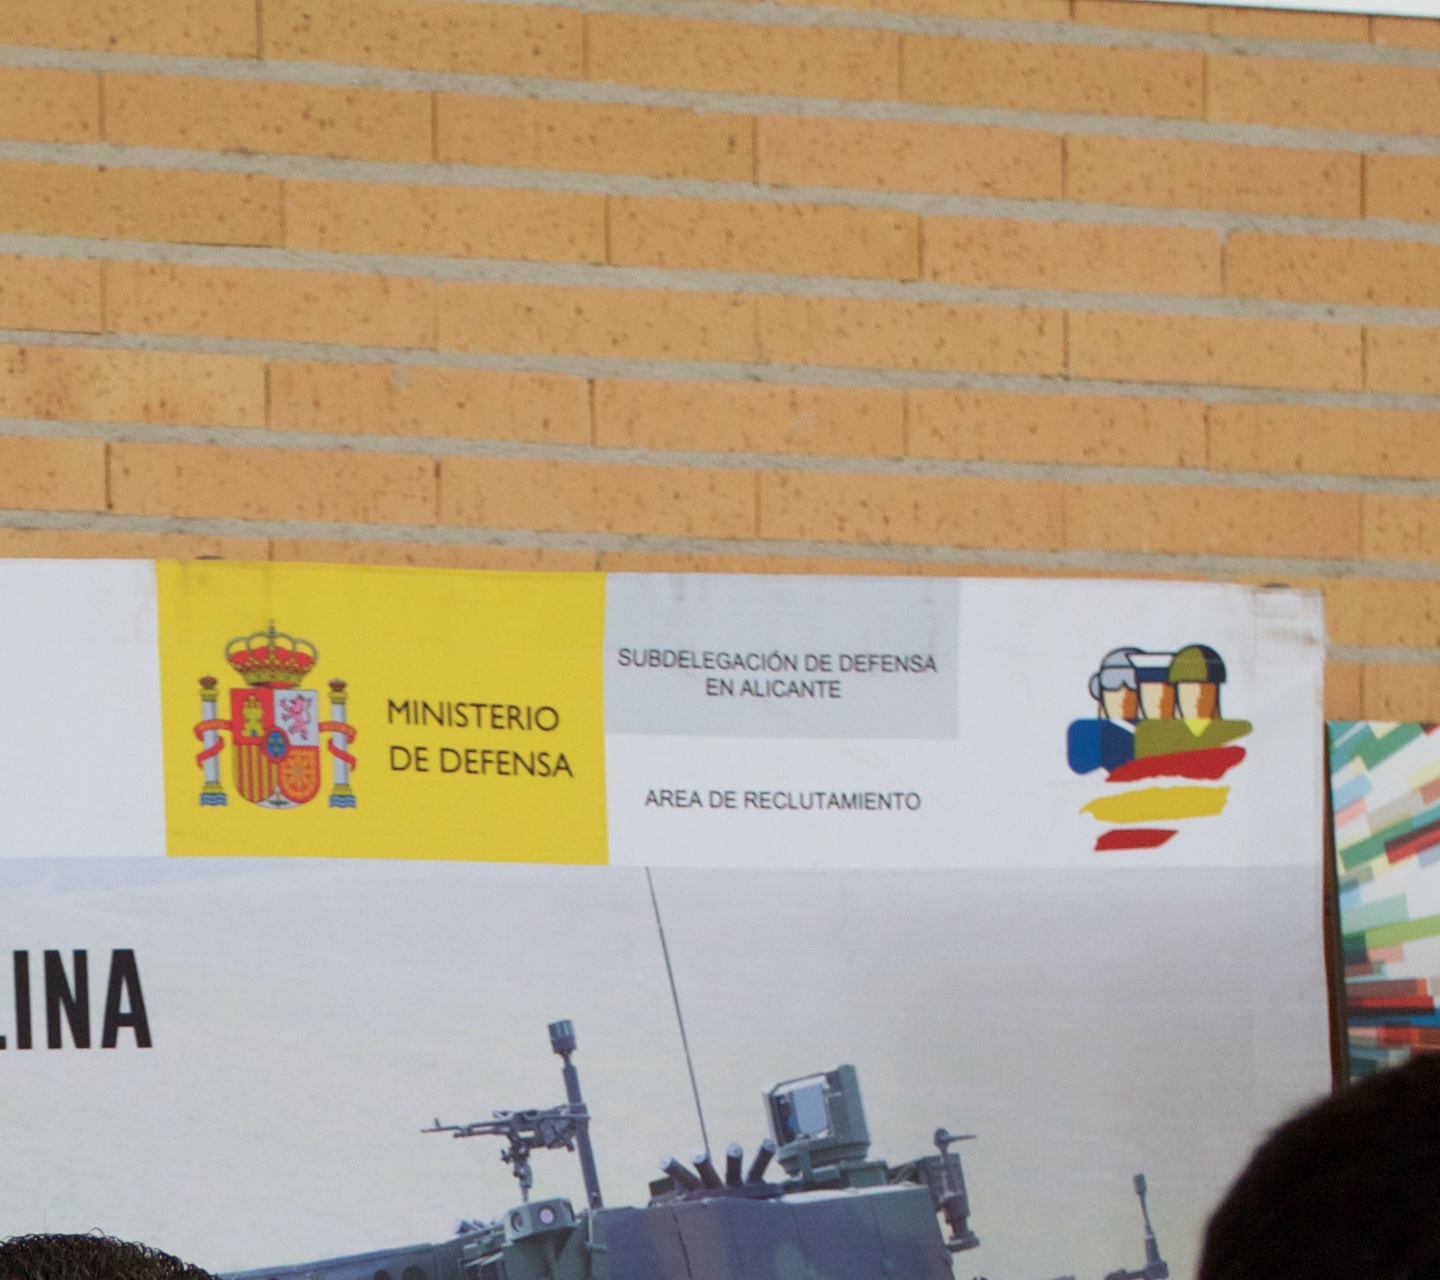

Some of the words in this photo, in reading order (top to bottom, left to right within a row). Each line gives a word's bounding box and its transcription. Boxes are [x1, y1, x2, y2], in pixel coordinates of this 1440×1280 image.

[617, 645, 798, 675] SUBDELEGACIÓN
[805, 653, 838, 673] DE
[840, 653, 938, 675] DEFENSA
[705, 677, 733, 697] EN
[740, 677, 842, 700] ALICANTE
[386, 698, 561, 733] MINISTERIO
[389, 745, 430, 776] DE
[440, 747, 574, 780] DEFENSA
[645, 790, 704, 810] AREA
[709, 790, 739, 810] DE
[745, 790, 922, 812] RECLUTAMIENTO
